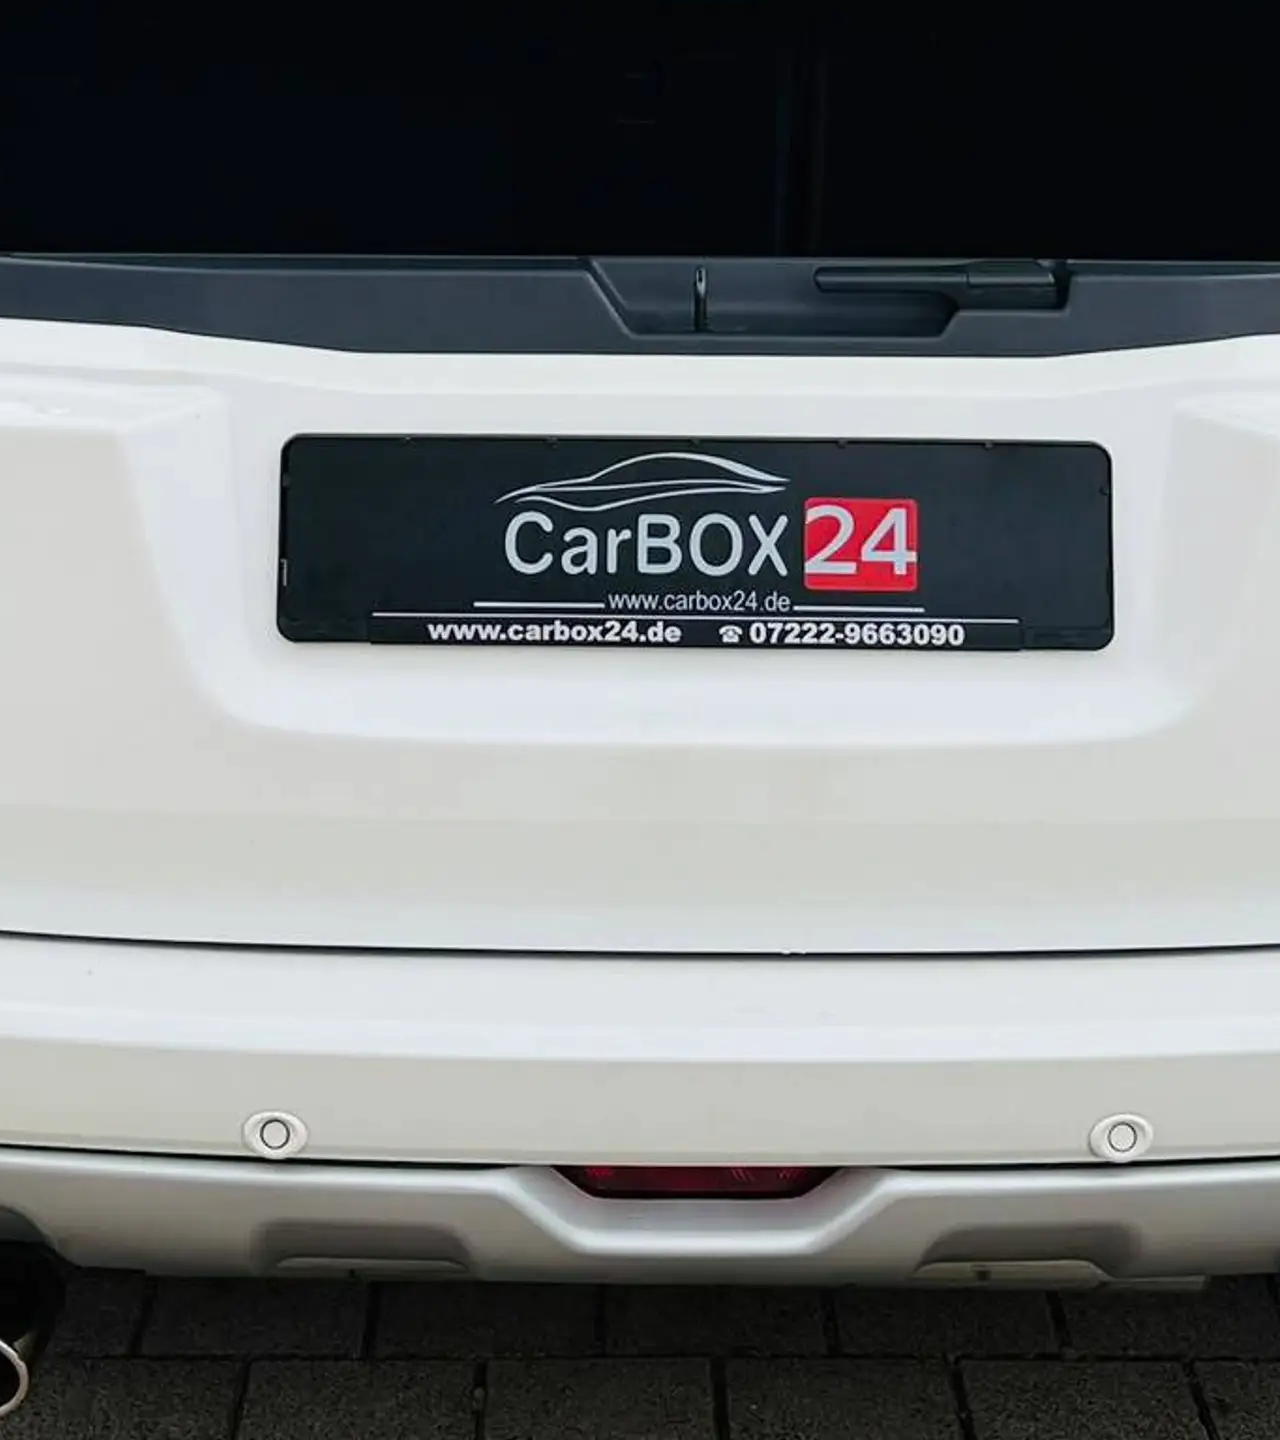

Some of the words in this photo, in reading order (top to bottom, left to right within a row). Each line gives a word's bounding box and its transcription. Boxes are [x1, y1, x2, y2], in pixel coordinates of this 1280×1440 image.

[805, 504, 917, 575] 24
[608, 591, 790, 611] www.carbox24.de
[427, 620, 682, 642] www.carbox24.de
[749, 622, 965, 645] 07222-9663090
